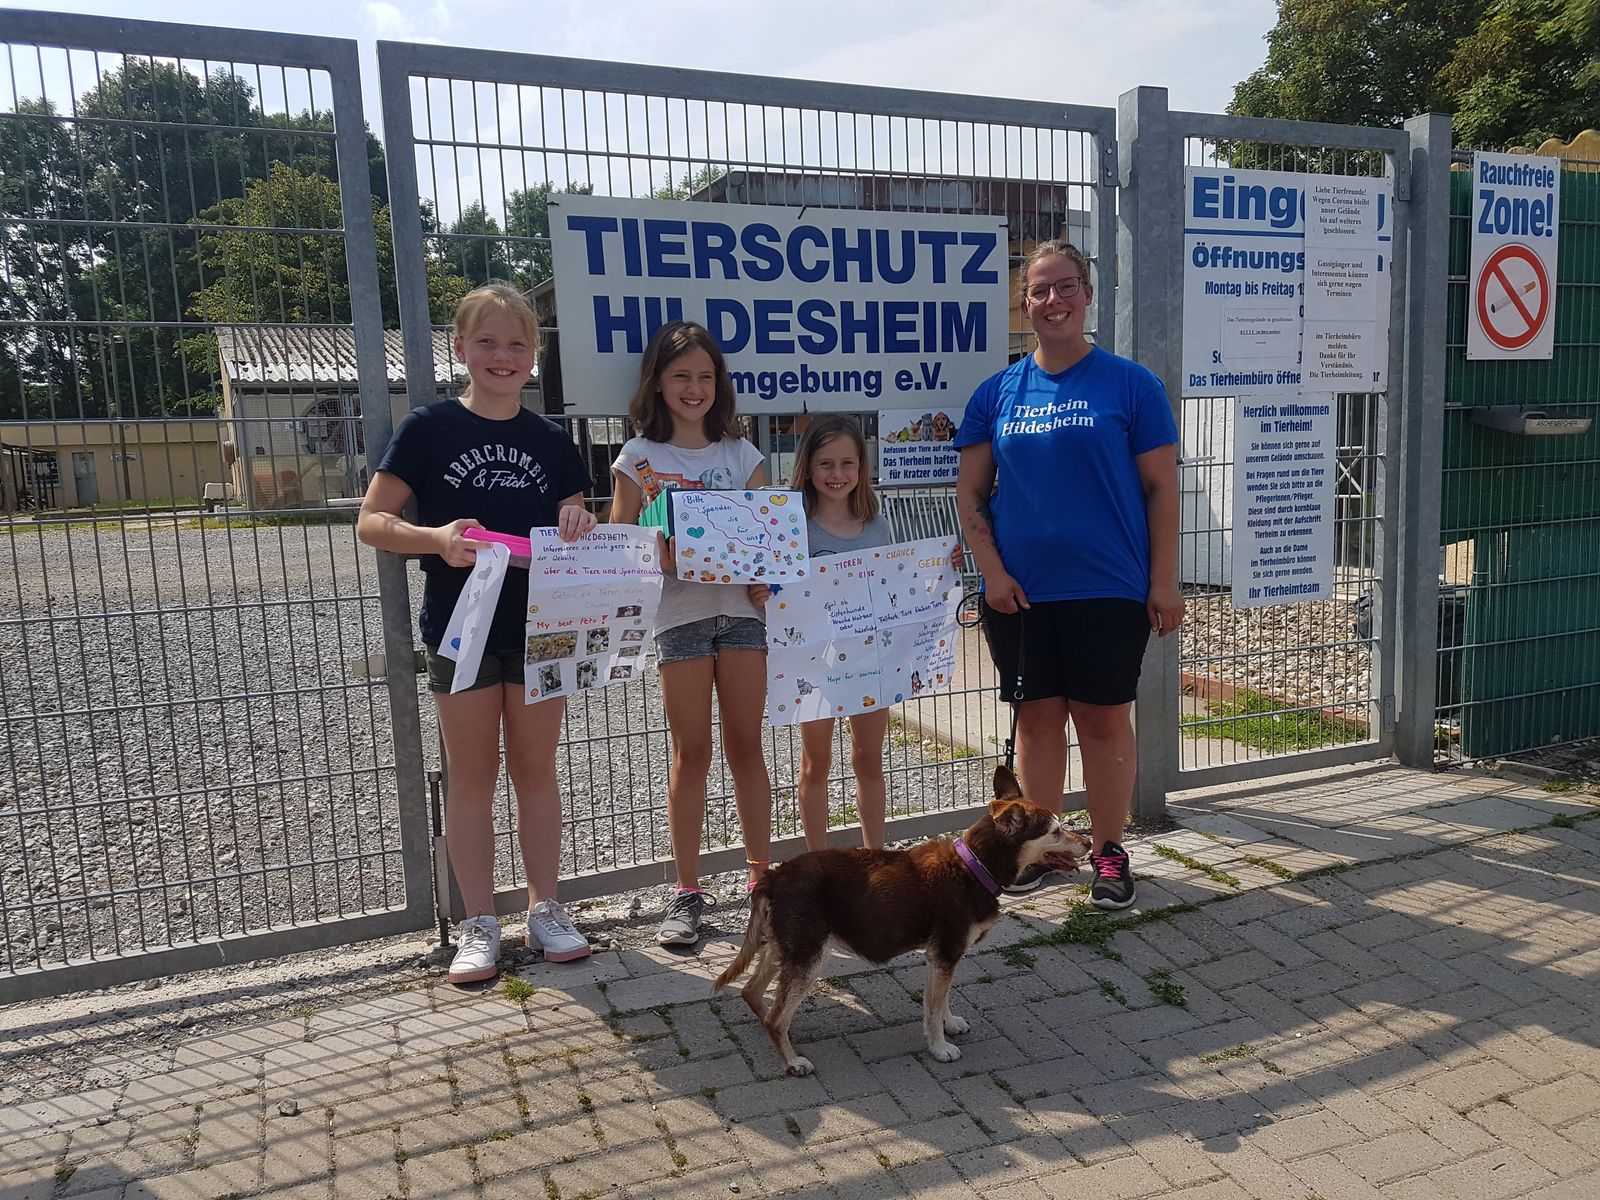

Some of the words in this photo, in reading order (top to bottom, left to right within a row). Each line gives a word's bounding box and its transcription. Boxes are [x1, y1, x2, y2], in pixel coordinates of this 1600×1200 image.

[1480, 160, 1555, 189] Rauchfreie
[1332, 186, 1367, 196] Tierfreunde!
[1312, 196, 1331, 205] Wegen
[1332, 197, 1353, 205] Corona
[1354, 198, 1370, 206] bleibt
[1337, 207, 1361, 215] Gelände
[1478, 189, 1554, 238] Zone!
[1339, 217, 1362, 225] weiteres
[567, 215, 998, 284] TIERSCHUTZ
[1317, 260, 1351, 269] Gassigänger
[1311, 269, 1347, 278] Interessenten
[1348, 271, 1369, 279] können
[1205, 281, 1241, 297] Montag
[1245, 281, 1259, 295] bis
[1262, 281, 1294, 298] Freitag
[1328, 281, 1344, 289] gerne
[1315, 332, 1323, 340] im
[1324, 332, 1361, 340] Tierheimbüro
[728, 364, 882, 400] mgebung
[894, 362, 947, 391] e.V.
[1189, 373, 1207, 387] Das
[1210, 371, 1273, 386] Tierheimbüro
[1276, 370, 1301, 385] öffne
[1013, 398, 1089, 419] Tierheim
[1243, 405, 1277, 418] Herzlich
[1280, 404, 1330, 417] willkommen
[1000, 413, 1095, 437] Hildesheim
[1260, 420, 1272, 433] im
[1274, 419, 1313, 432] Tierheim!
[883, 446, 907, 454] Anfassen
[1251, 442, 1259, 451] Sie
[1261, 441, 1281, 450] können
[1282, 440, 1293, 449] sich
[1295, 441, 1310, 450] gerne
[1311, 440, 1321, 448] auf
[883, 457, 897, 467] Das
[899, 456, 932, 466] Tierheim
[934, 454, 958, 466] haftet
[1245, 455, 1269, 463] unserem
[1271, 453, 1292, 462] Gelände
[1293, 452, 1326, 461] umschauen.
[443, 444, 549, 494] ABERCROMBIE
[889, 470, 901, 480] für
[903, 468, 930, 479] Kratzer
[933, 467, 949, 478] oder
[1246, 471, 1255, 480] Bei
[1256, 470, 1275, 480] Fragen
[1277, 469, 1290, 477] rund
[1291, 469, 1300, 477] um
[1301, 468, 1310, 476] die
[1311, 467, 1324, 476] Tiere
[473, 468, 487, 488] &
[487, 470, 531, 491] Fitch
[1247, 483, 1268, 492] wenden
[1270, 482, 1278, 490] Sie
[1280, 481, 1290, 490] sich
[1292, 480, 1305, 489] bitte
[1315, 479, 1323, 487] die
[686, 494, 705, 504] Bitte
[702, 505, 732, 515] Spenden
[1248, 506, 1263, 516] Diese
[1264, 505, 1276, 515] sind
[1278, 504, 1293, 514] durch
[1295, 503, 1321, 513] kornblaue
[1247, 518, 1271, 528] Kleidung
[1273, 517, 1283, 526] mit
[1284, 517, 1293, 525] der
[1295, 515, 1321, 524] Aufschrift
[580, 532, 628, 541] HILDESHEIM
[1255, 530, 1279, 539] Tierheim
[1288, 527, 1314, 537] erkennen.
[594, 542, 607, 550] sich
[610, 544, 630, 552] gerne
[1260, 546, 1273, 555] Auch
[1283, 544, 1291, 553] die
[1293, 544, 1308, 552] Dame
[886, 548, 916, 560] CHANCE
[834, 557, 863, 571] TIEREN
[918, 556, 949, 569] GEBEN
[1260, 556, 1296, 566] Tierheimbüro
[1297, 555, 1316, 563] können
[544, 566, 560, 575] über
[565, 566, 578, 575] die
[582, 566, 601, 575] Tiere
[602, 567, 617, 575] und
[858, 570, 875, 579] EINE
[1253, 570, 1261, 579] Sie
[1262, 569, 1273, 578] sich
[1275, 568, 1290, 578] gerne
[1292, 566, 1314, 575] wenden.
[1249, 586, 1261, 599] Ihr
[1264, 582, 1320, 597] Tierheimteam
[536, 622, 550, 630] My
[558, 620, 574, 628] best
[827, 675, 841, 684] Hope
